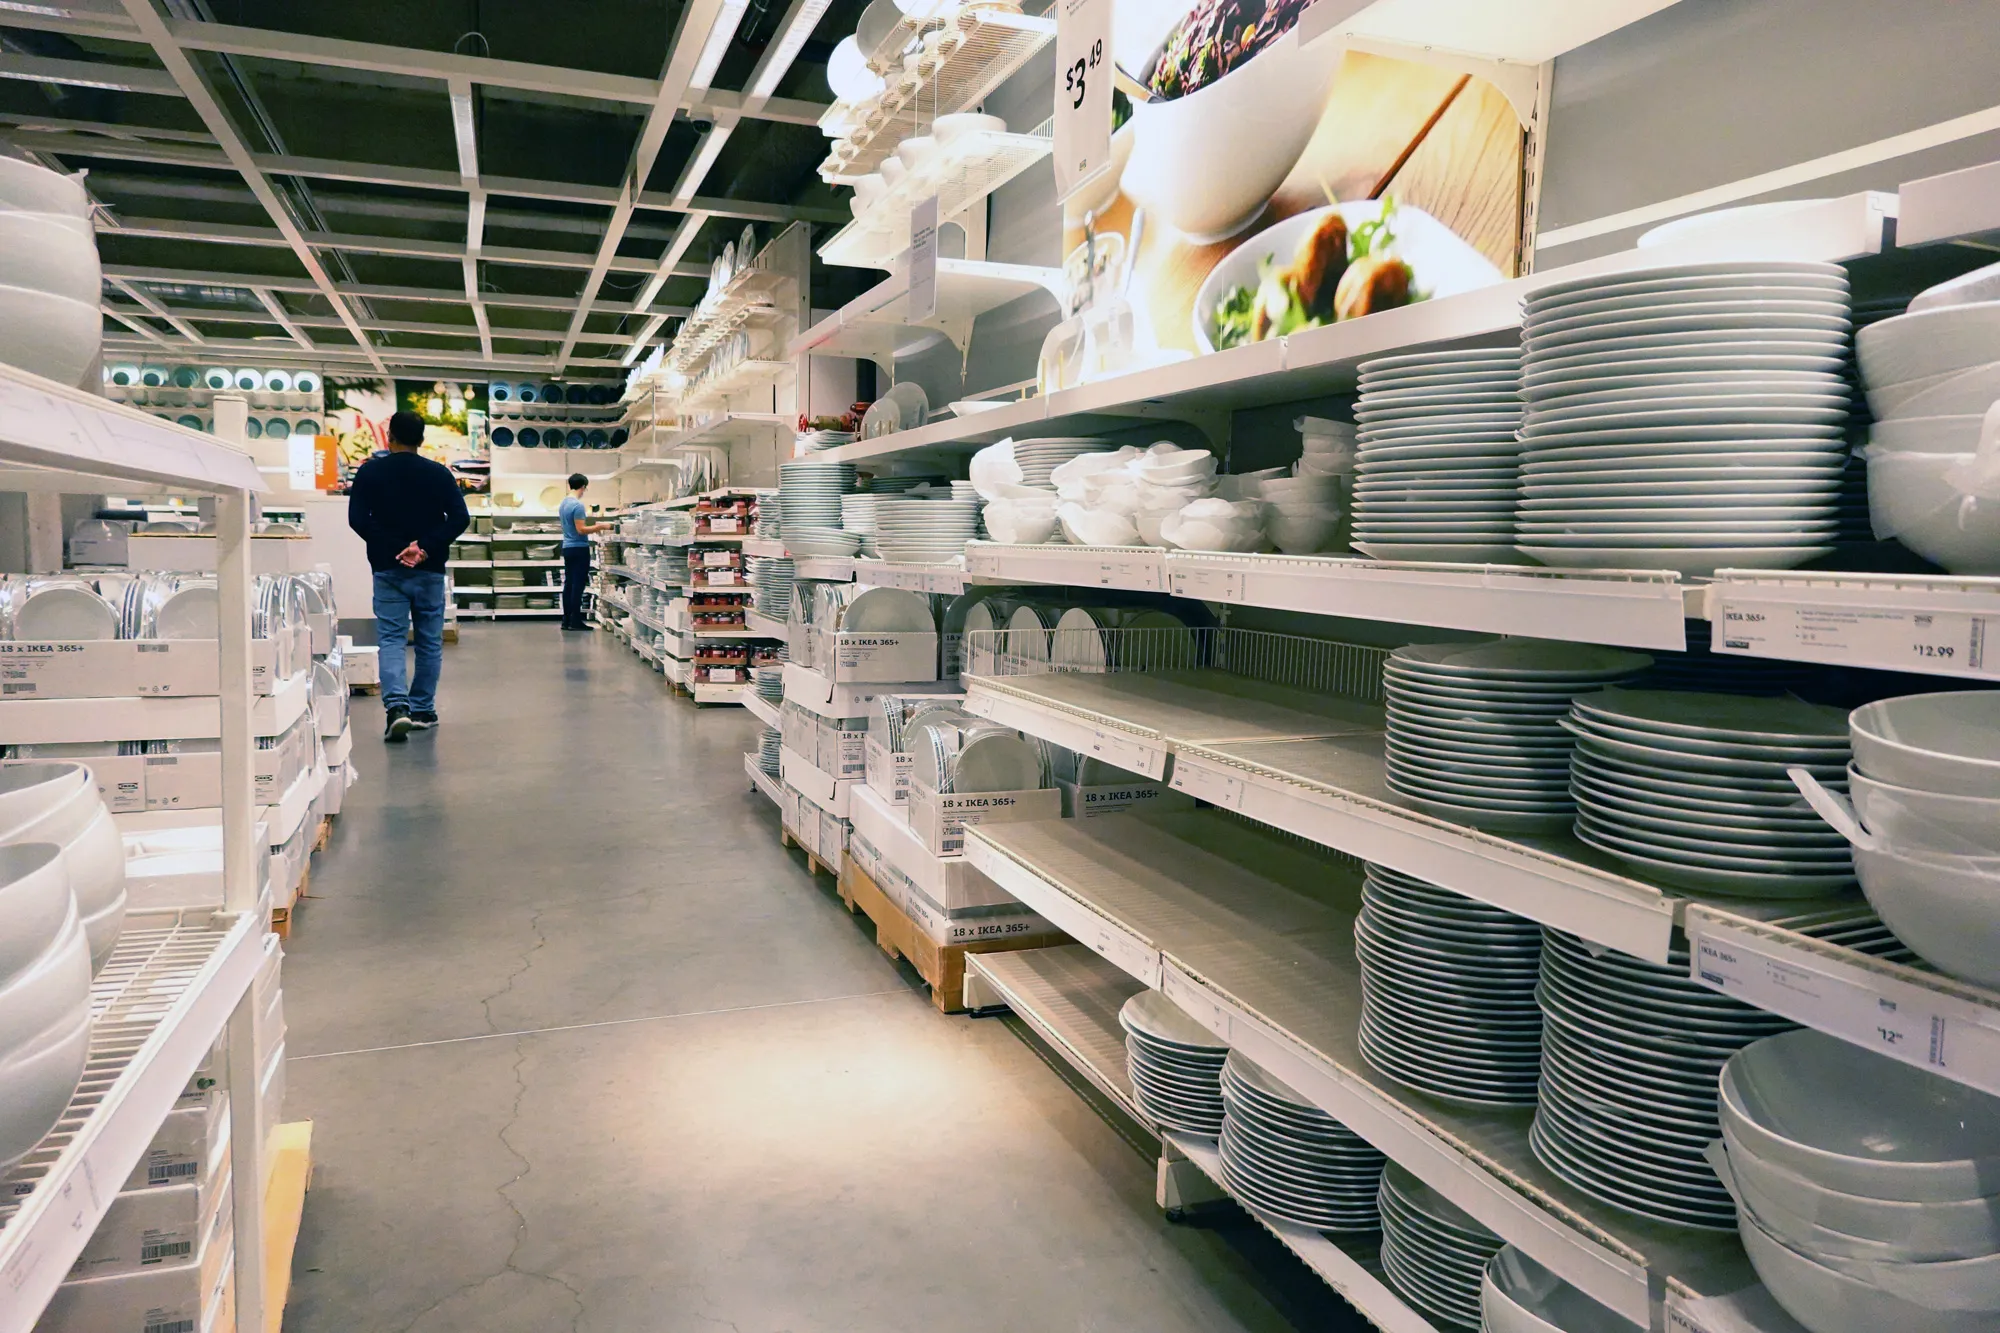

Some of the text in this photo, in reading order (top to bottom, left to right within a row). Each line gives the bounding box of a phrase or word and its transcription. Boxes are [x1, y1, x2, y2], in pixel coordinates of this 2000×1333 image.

[315, 450, 326, 476] New
[1745, 613, 1765, 621] 365+
[1, 645, 13, 653] 18
[27, 645, 54, 653] IKEA
[57, 644, 84, 653] 365+
[1085, 793, 1097, 802] 18
[1108, 791, 1132, 800] IKEA
[1135, 789, 1159, 799] 365+
[942, 800, 954, 808] 18
[965, 799, 989, 807] IKEA
[992, 797, 1016, 806] 365+
[953, 928, 965, 936] 18
[977, 925, 1002, 935] IKEA
[1005, 923, 1030, 933] 365+
